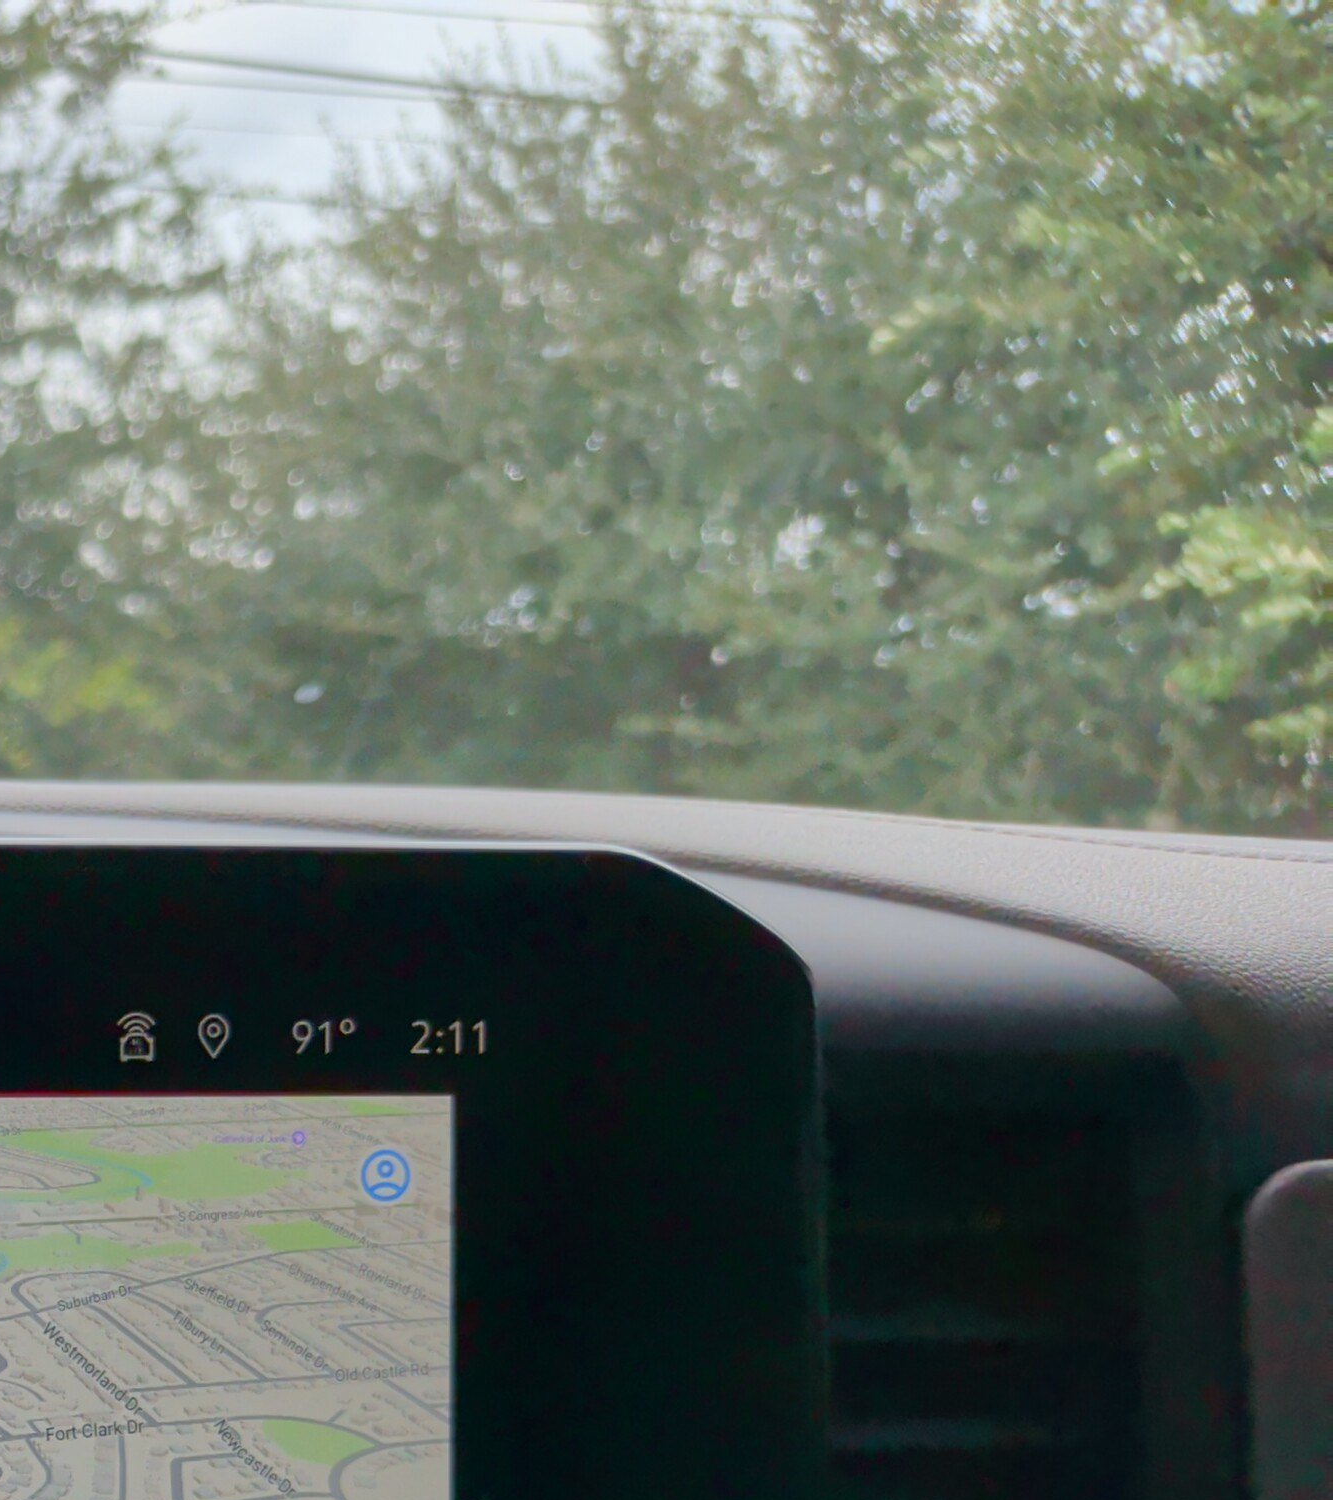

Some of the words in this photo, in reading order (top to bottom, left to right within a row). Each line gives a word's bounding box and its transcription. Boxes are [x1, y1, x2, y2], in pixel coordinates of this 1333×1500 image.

[292, 1018, 357, 1055] 91°
[410, 1020, 488, 1056] 2:11
[178, 1211, 186, 1223] S
[187, 1210, 240, 1225] Congress
[241, 1208, 263, 1220] Ave
[309, 1210, 357, 1241] Sheraton
[184, 1278, 236, 1309] Sheffield
[237, 1301, 251, 1314] Dr
[288, 1263, 356, 1302] Chippendale
[358, 1263, 412, 1295] Rowland
[57, 1289, 115, 1312] Suburban
[118, 1284, 133, 1298] Dr
[173, 1309, 210, 1344] Tilbury
[209, 1337, 226, 1354] Ln
[261, 1320, 313, 1362] Seminole
[313, 1355, 329, 1371] Dr
[43, 1321, 129, 1402] Westmorland
[125, 1396, 144, 1416] Dr
[334, 1366, 358, 1382] Old
[362, 1364, 407, 1381] Castle
[409, 1361, 429, 1377] Rd
[46, 1425, 78, 1442] Fort
[81, 1422, 124, 1439] Clark
[126, 1418, 145, 1435] Dr
[213, 1418, 279, 1485] Newcastle
[277, 1478, 297, 1498] Dr
